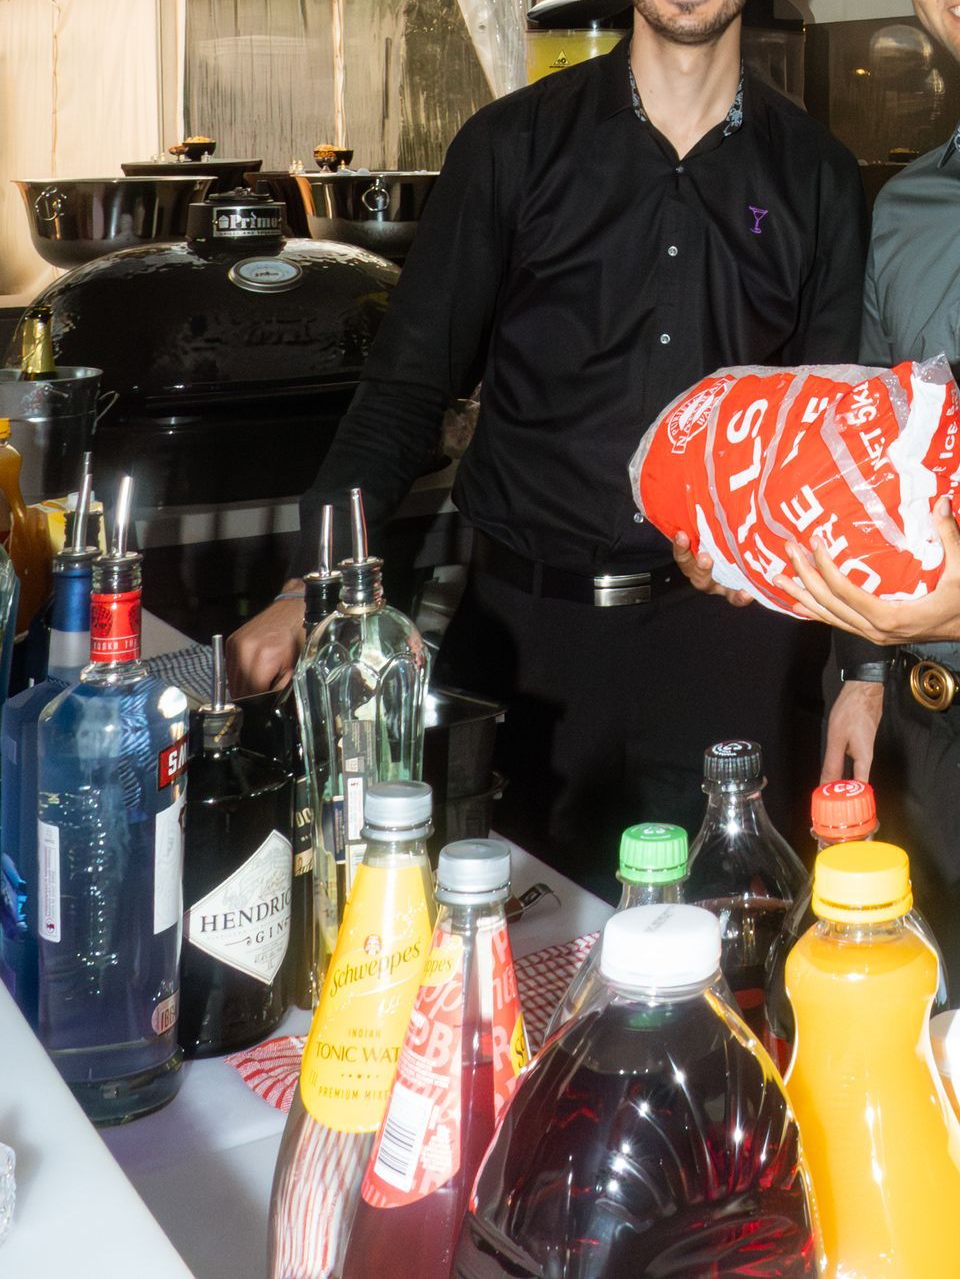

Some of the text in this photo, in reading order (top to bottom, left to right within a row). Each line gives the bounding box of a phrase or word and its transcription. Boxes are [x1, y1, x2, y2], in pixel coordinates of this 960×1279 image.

[229, 211, 278, 229] Primo
[727, 398, 806, 590] ELLS
[330, 938, 422, 998] Schweppes
[348, 1027, 382, 1039] INDIAN
[316, 1041, 356, 1063] TONIC
[318, 1085, 359, 1100] PREMIUM
